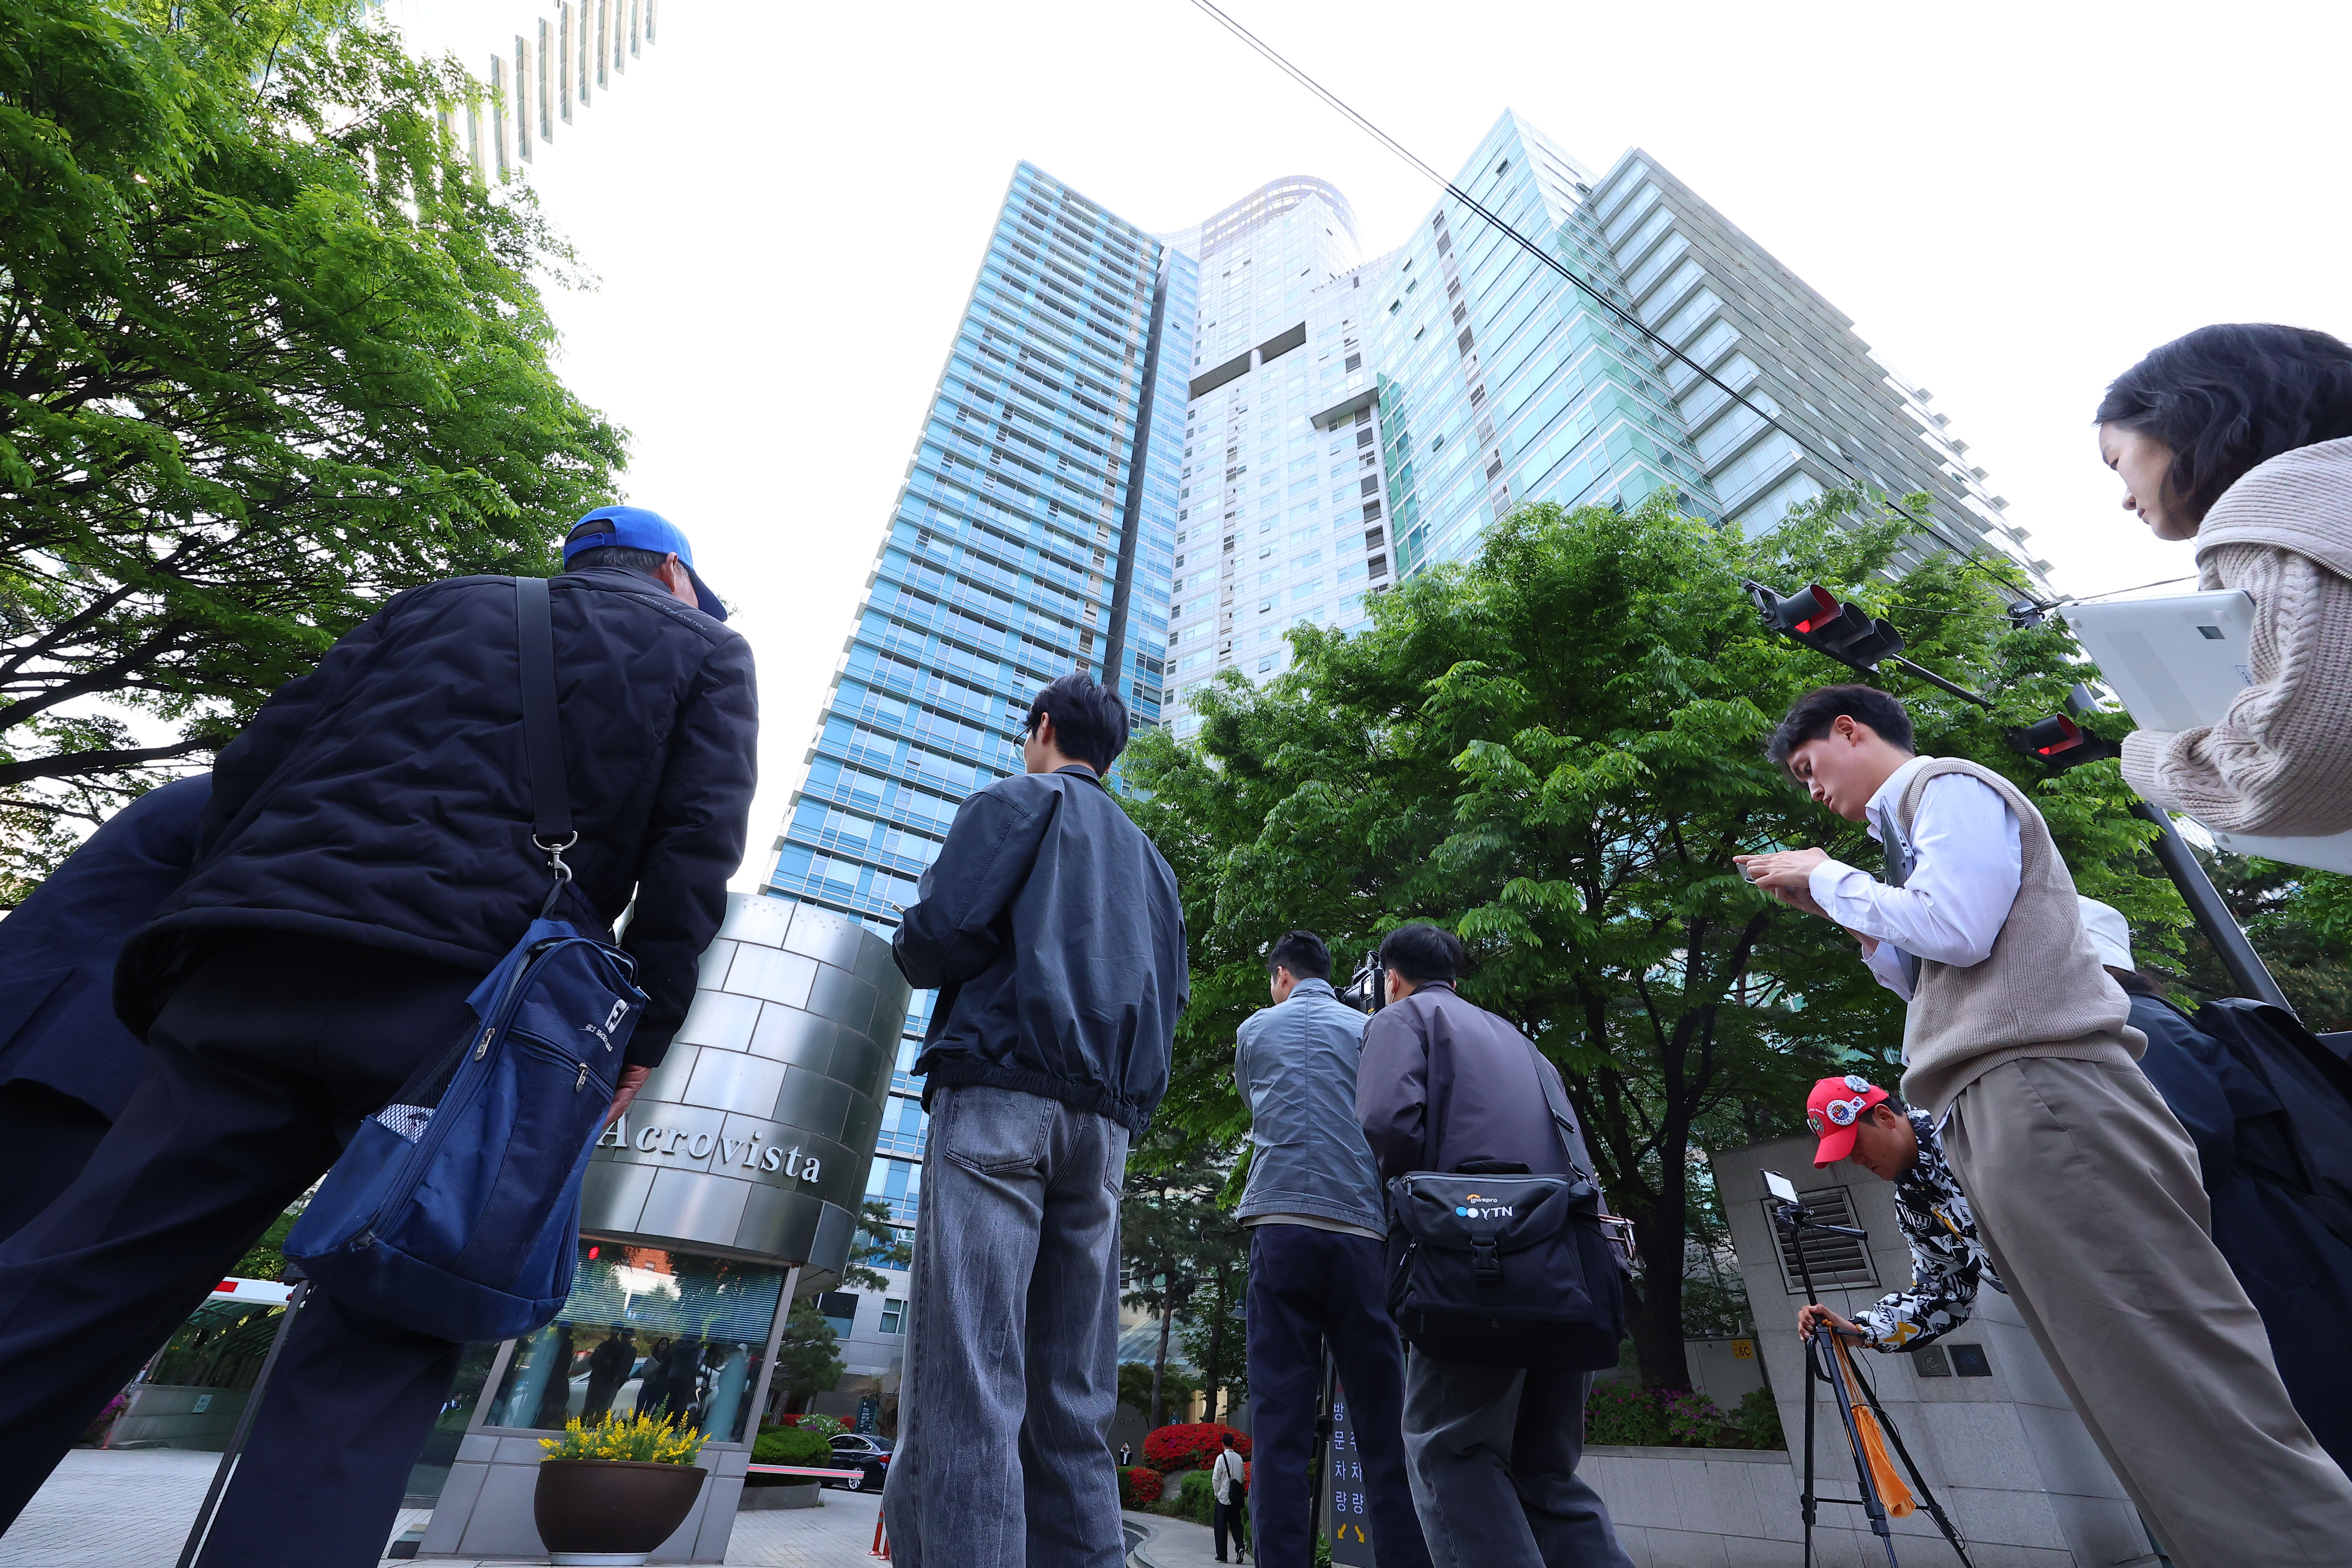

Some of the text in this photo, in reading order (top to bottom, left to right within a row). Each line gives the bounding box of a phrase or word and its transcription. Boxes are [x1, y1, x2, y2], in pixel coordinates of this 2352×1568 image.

[635, 594, 707, 631] PROTECTION SYSTEM
[596, 1111, 821, 1183] Acrovista
[1480, 1206, 1513, 1220] YTN
[1739, 1347, 1750, 1356] 6C
